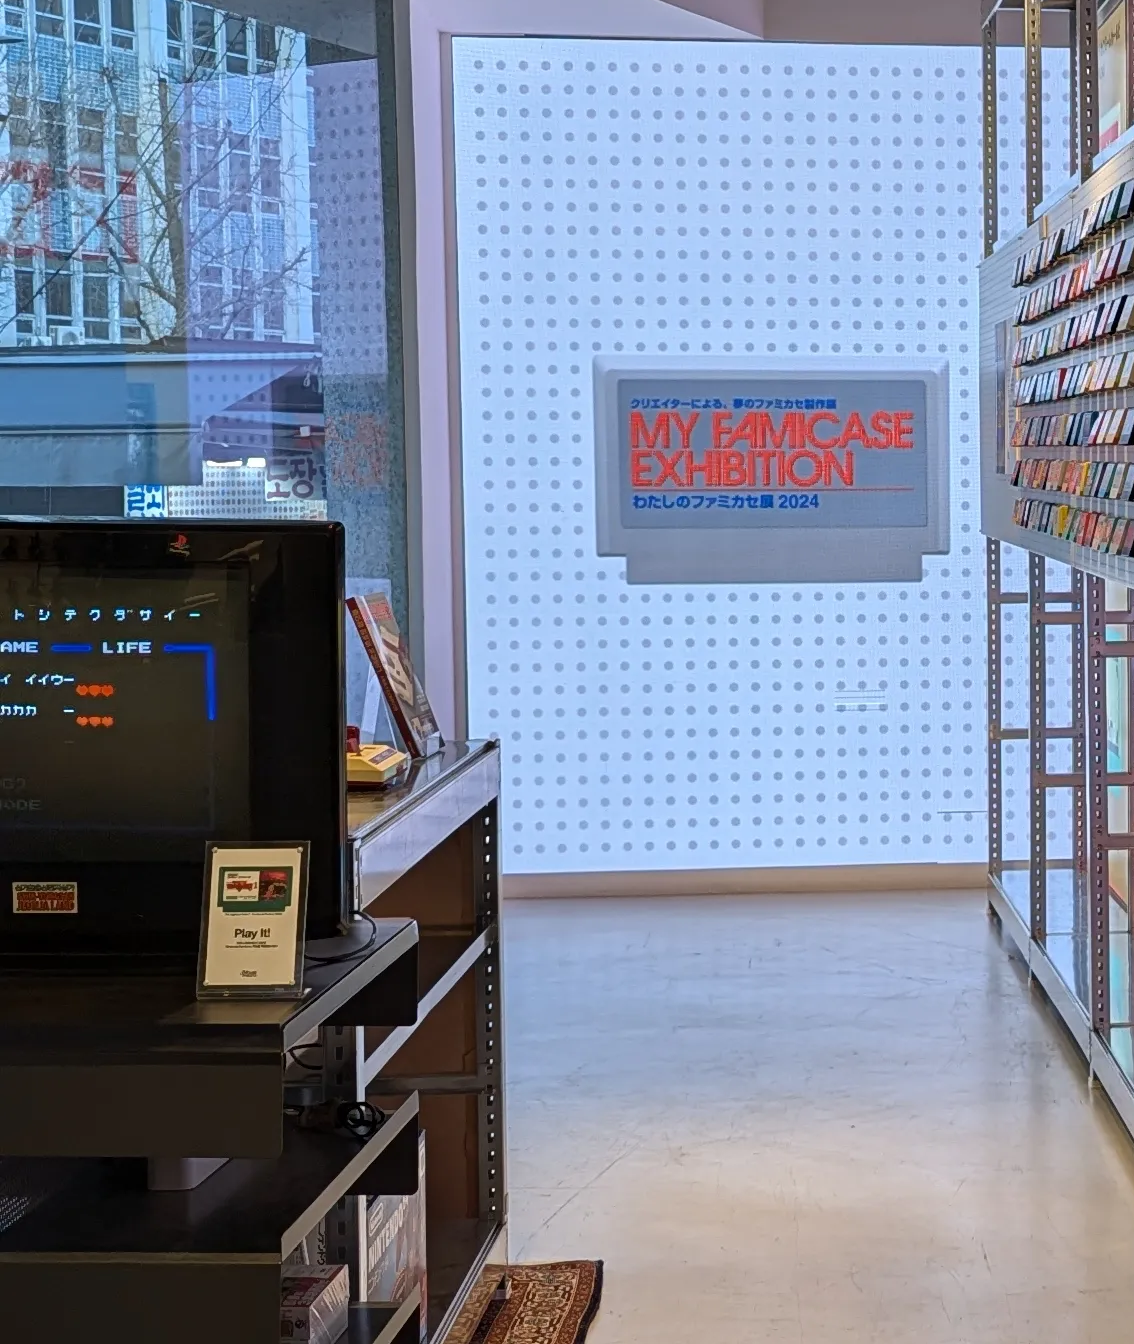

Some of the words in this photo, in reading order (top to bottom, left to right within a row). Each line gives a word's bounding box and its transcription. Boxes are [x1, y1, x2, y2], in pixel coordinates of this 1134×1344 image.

[629, 411, 700, 449] MY
[712, 411, 914, 449] FAMICASE
[630, 450, 854, 487] EXHIBITION
[633, 494, 774, 510] わたしのファミカセ展
[779, 494, 819, 509] 2024
[102, 641, 152, 654] LIFE
[234, 928, 258, 940] Play
